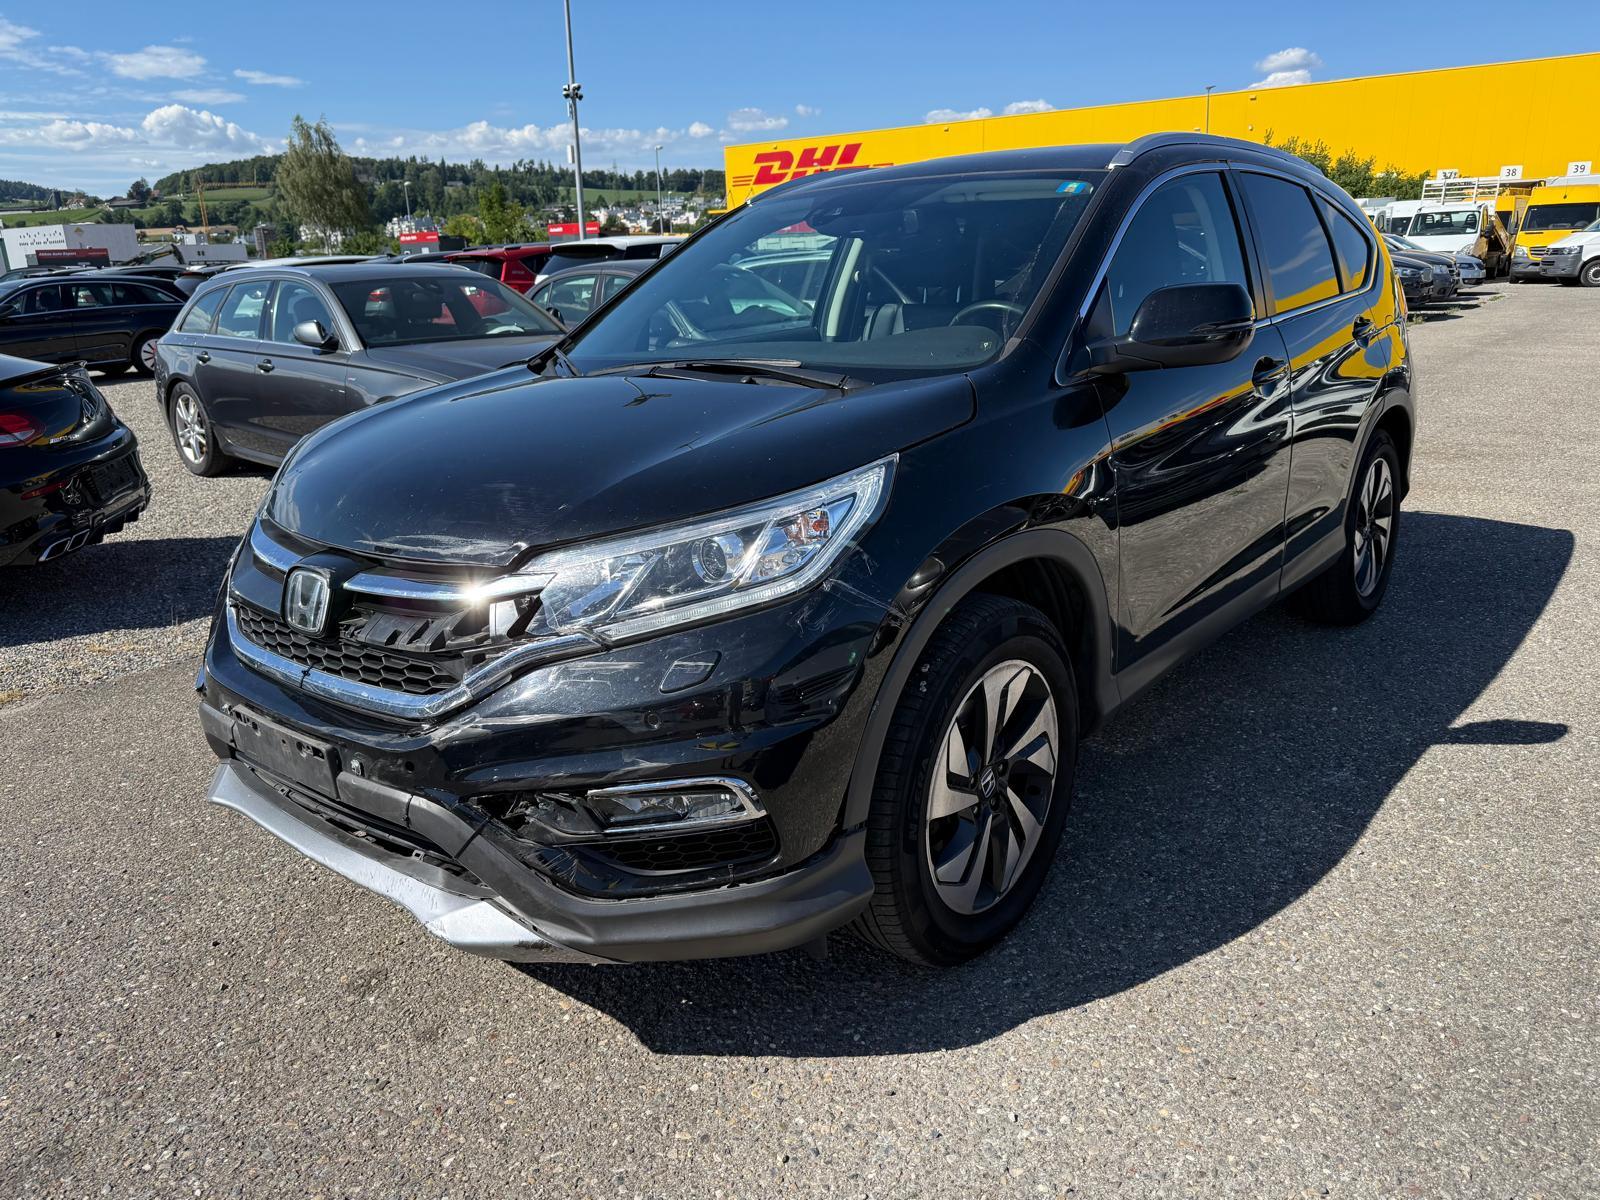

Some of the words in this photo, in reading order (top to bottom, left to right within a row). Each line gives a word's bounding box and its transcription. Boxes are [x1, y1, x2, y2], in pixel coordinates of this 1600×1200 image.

[753, 143, 869, 185] DHL
[1573, 164, 1586, 174] 39
[1505, 168, 1517, 177] 38
